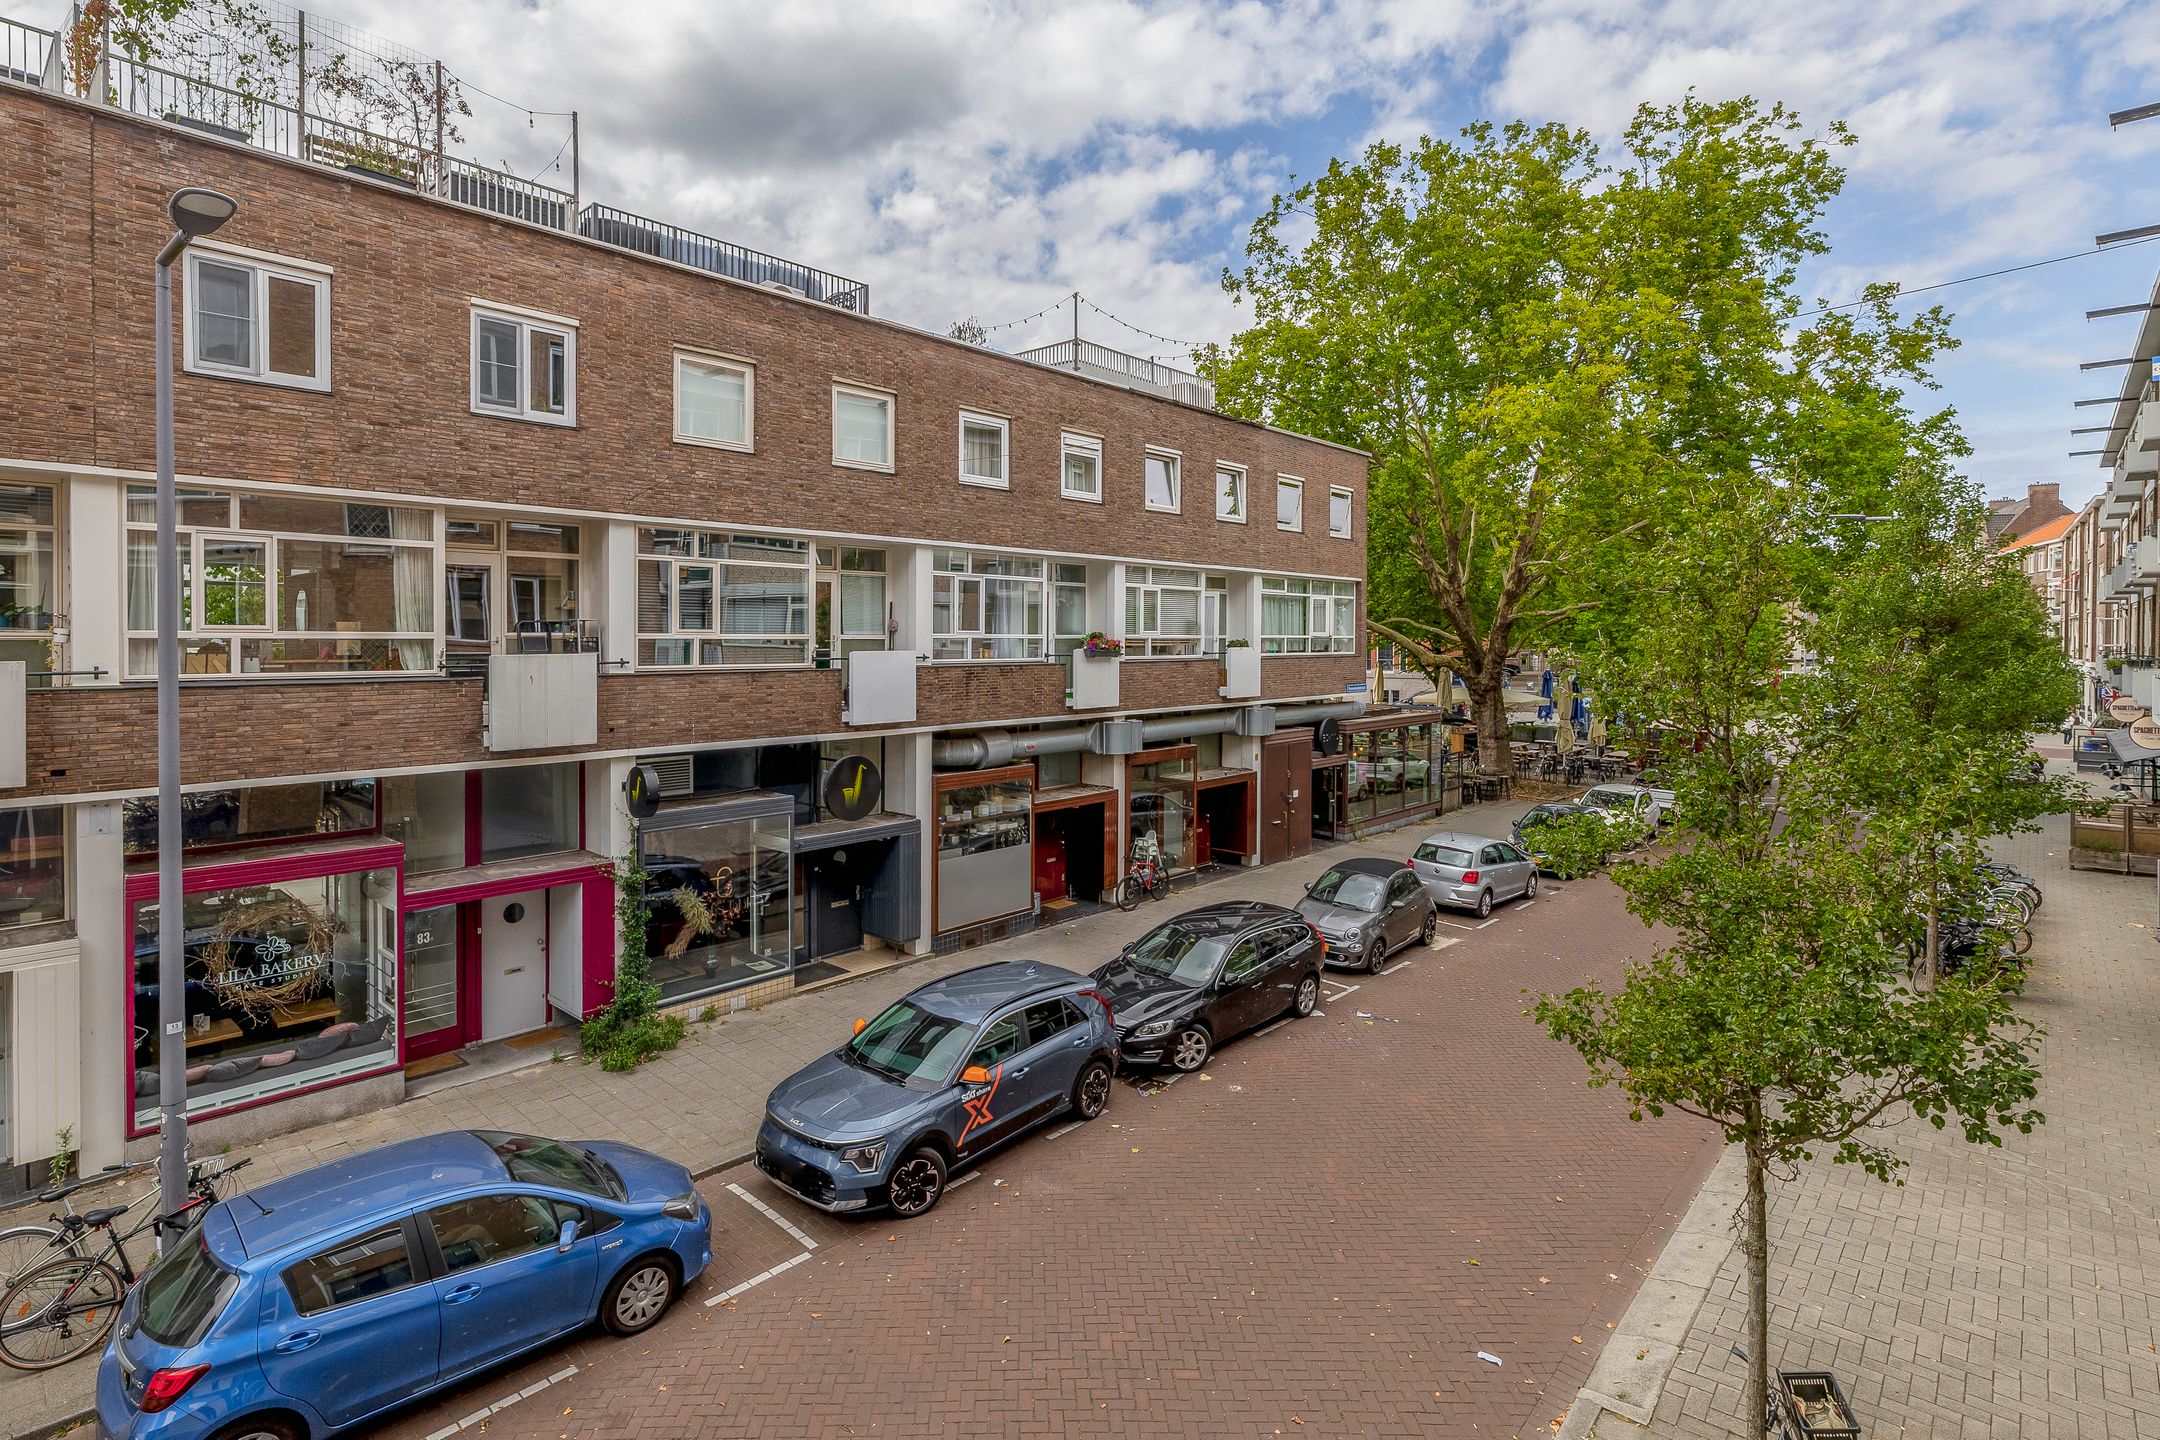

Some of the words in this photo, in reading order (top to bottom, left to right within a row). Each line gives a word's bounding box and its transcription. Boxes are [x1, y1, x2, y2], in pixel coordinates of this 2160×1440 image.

[219, 967, 256, 985] LILA
[260, 952, 326, 977] BAKERY
[235, 981, 264, 991] CAKE
[271, 971, 312, 984] STUDIO
